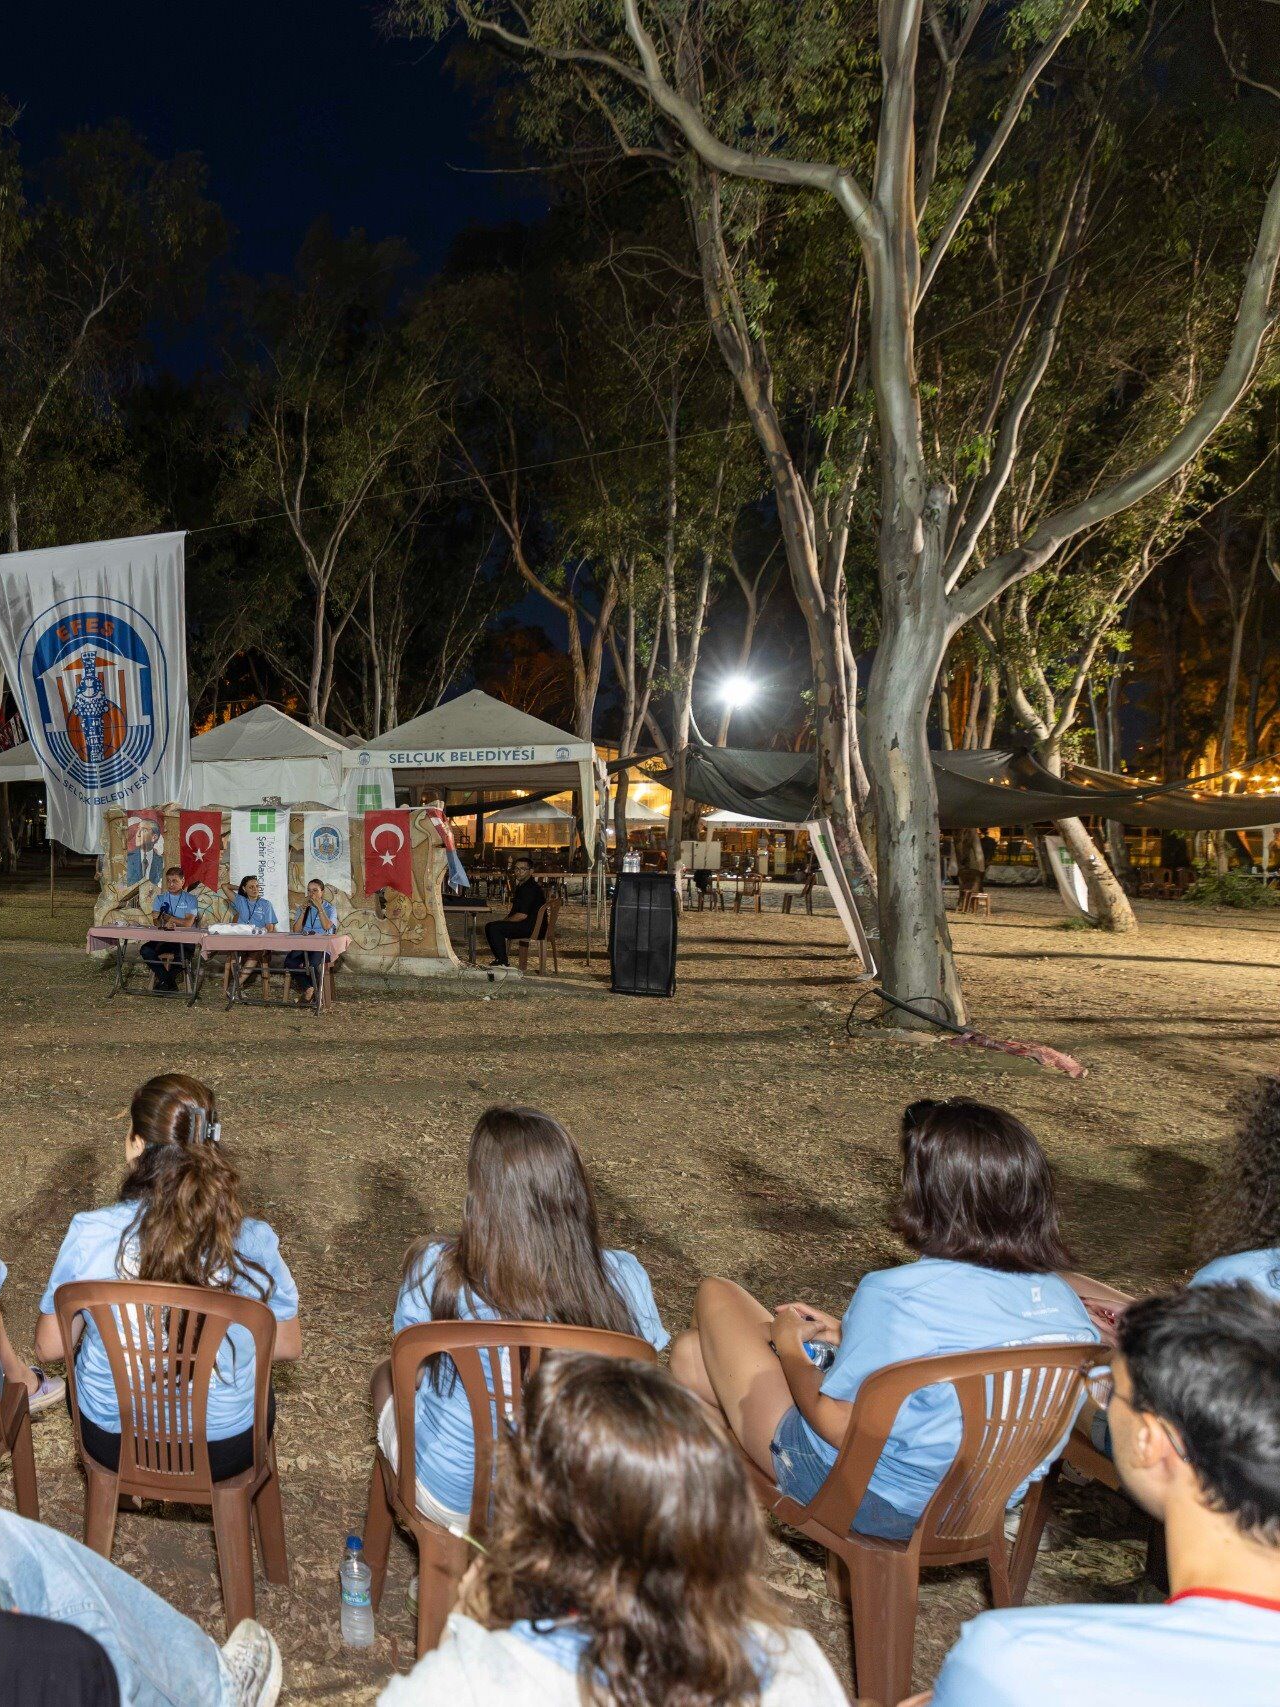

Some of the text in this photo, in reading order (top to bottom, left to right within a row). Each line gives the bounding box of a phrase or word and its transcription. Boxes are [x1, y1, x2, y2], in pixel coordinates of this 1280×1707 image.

[56, 617, 115, 641] EFES
[389, 747, 535, 765] SELÇUK BELEDİYESİ
[93, 773, 150, 805] BELEDİYESİ
[256, 836, 267, 858] Şehir
